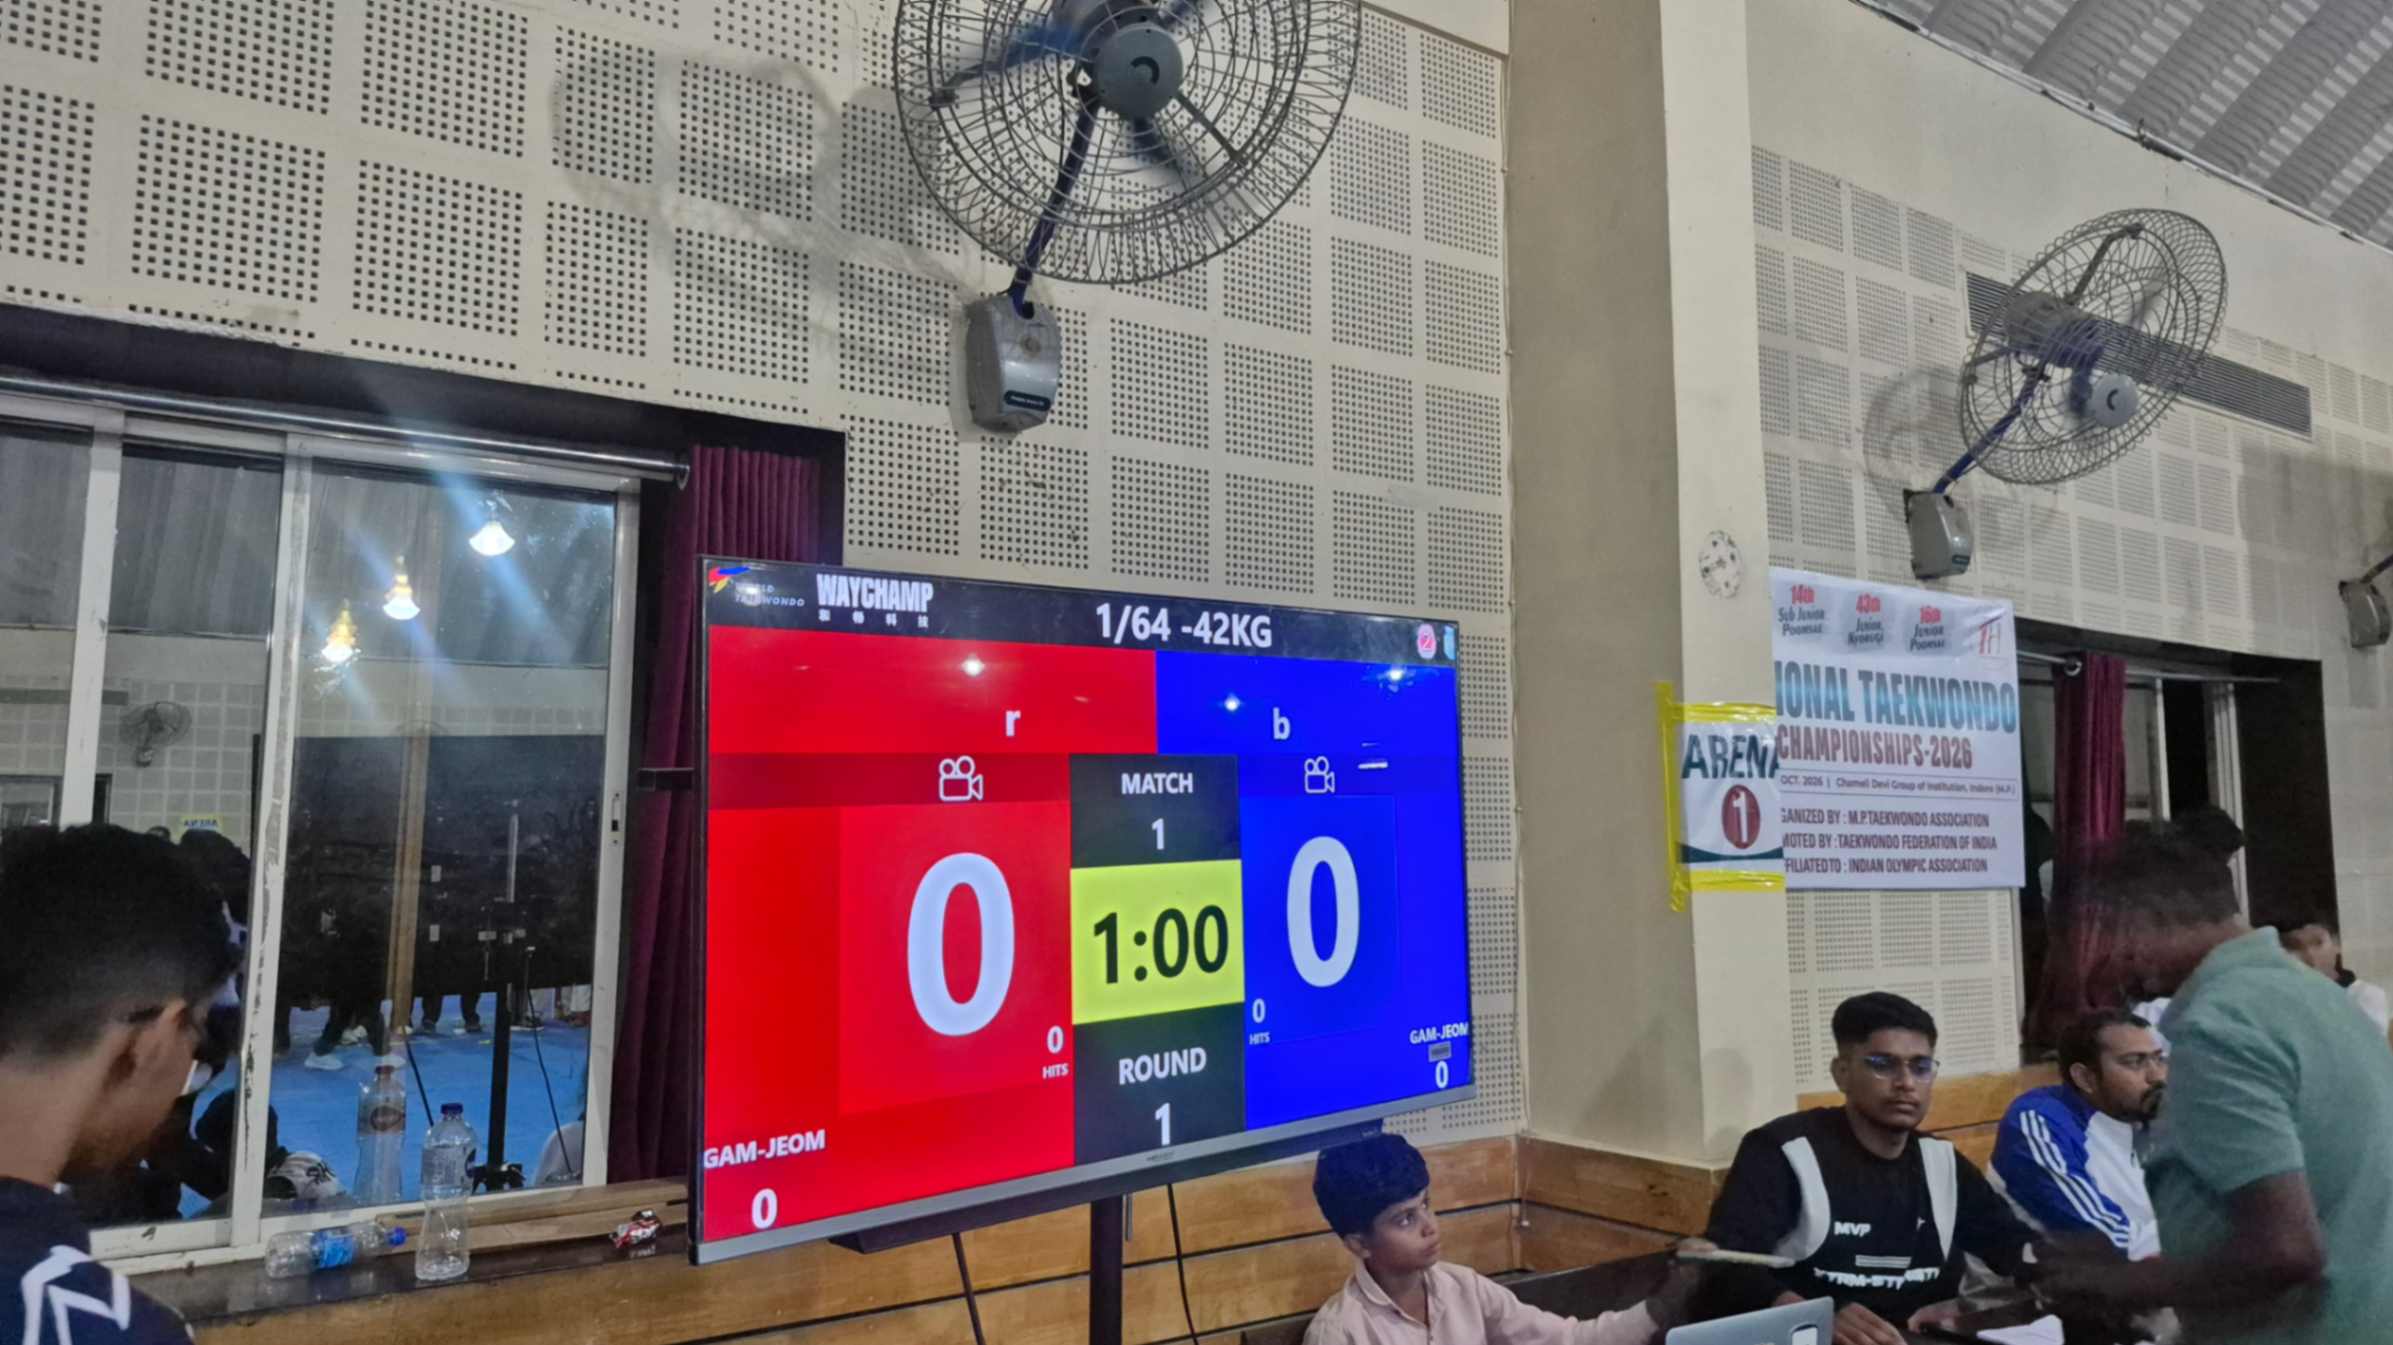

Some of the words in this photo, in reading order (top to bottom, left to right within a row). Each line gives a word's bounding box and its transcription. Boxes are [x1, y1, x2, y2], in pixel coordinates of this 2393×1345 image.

[816, 573, 934, 612] WAYCHAMP
[1096, 602, 1171, 644] 1/64
[1181, 611, 1272, 648] -42KG
[1858, 670, 2016, 734] TAEKWONDO
[1005, 708, 1020, 736] r
[1272, 707, 1291, 740] b
[1777, 724, 1973, 770] CHAMPIONSHIPS-2026
[1121, 772, 1194, 795] MATCH
[1733, 791, 1749, 843] 1
[1827, 809, 1840, 824] BY
[1930, 812, 1989, 828] ASSOCIATION
[1152, 818, 1165, 850] 1
[1818, 833, 1832, 849] BY
[1902, 835, 1957, 850] FEDERATION
[1959, 836, 1969, 850] OF
[1971, 836, 1997, 850] INDIA
[1848, 859, 1885, 873] INDIAN
[1886, 859, 1926, 873] OLYMPIC
[1928, 858, 1988, 873] ASSOCIATION
[1287, 836, 1360, 987] 0
[907, 852, 1015, 1036] 0
[1093, 905, 1229, 984] 1:00
[1252, 998, 1265, 1023] 0
[1047, 1026, 1064, 1054] 0
[1249, 1031, 1270, 1045] HITS
[1409, 1022, 1469, 1045] GAM-JEOM
[1042, 1063, 1069, 1079] HITS
[1118, 1047, 1207, 1085] ROUND
[1435, 1060, 1449, 1088] 0
[1154, 1102, 1171, 1146] 1
[703, 1129, 826, 1169] GAM-JEOM
[751, 1188, 778, 1230] 0
[1834, 1221, 1872, 1237] MVP
